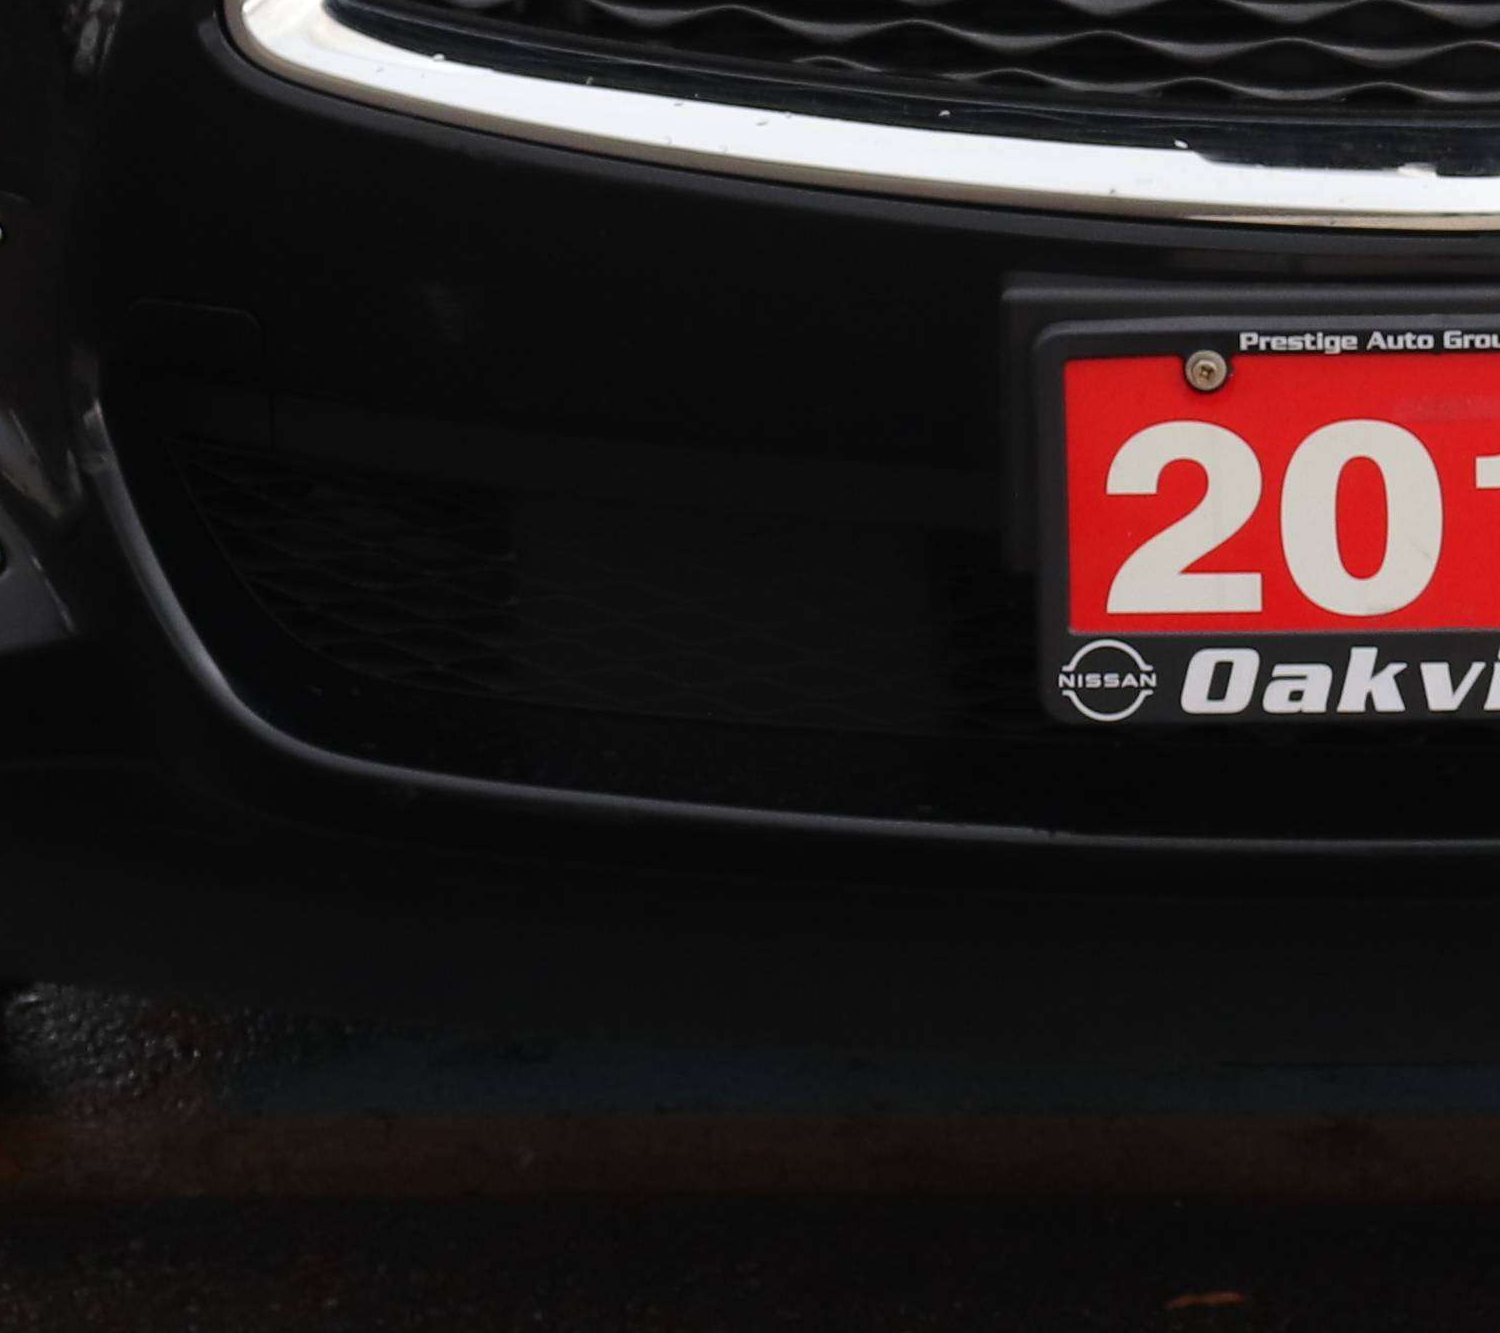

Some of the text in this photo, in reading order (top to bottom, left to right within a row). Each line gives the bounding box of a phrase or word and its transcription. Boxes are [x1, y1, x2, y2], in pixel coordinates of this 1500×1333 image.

[1239, 331, 1358, 355] Prestige
[1366, 331, 1435, 350] Auto
[1058, 672, 1157, 688] NISSAN
